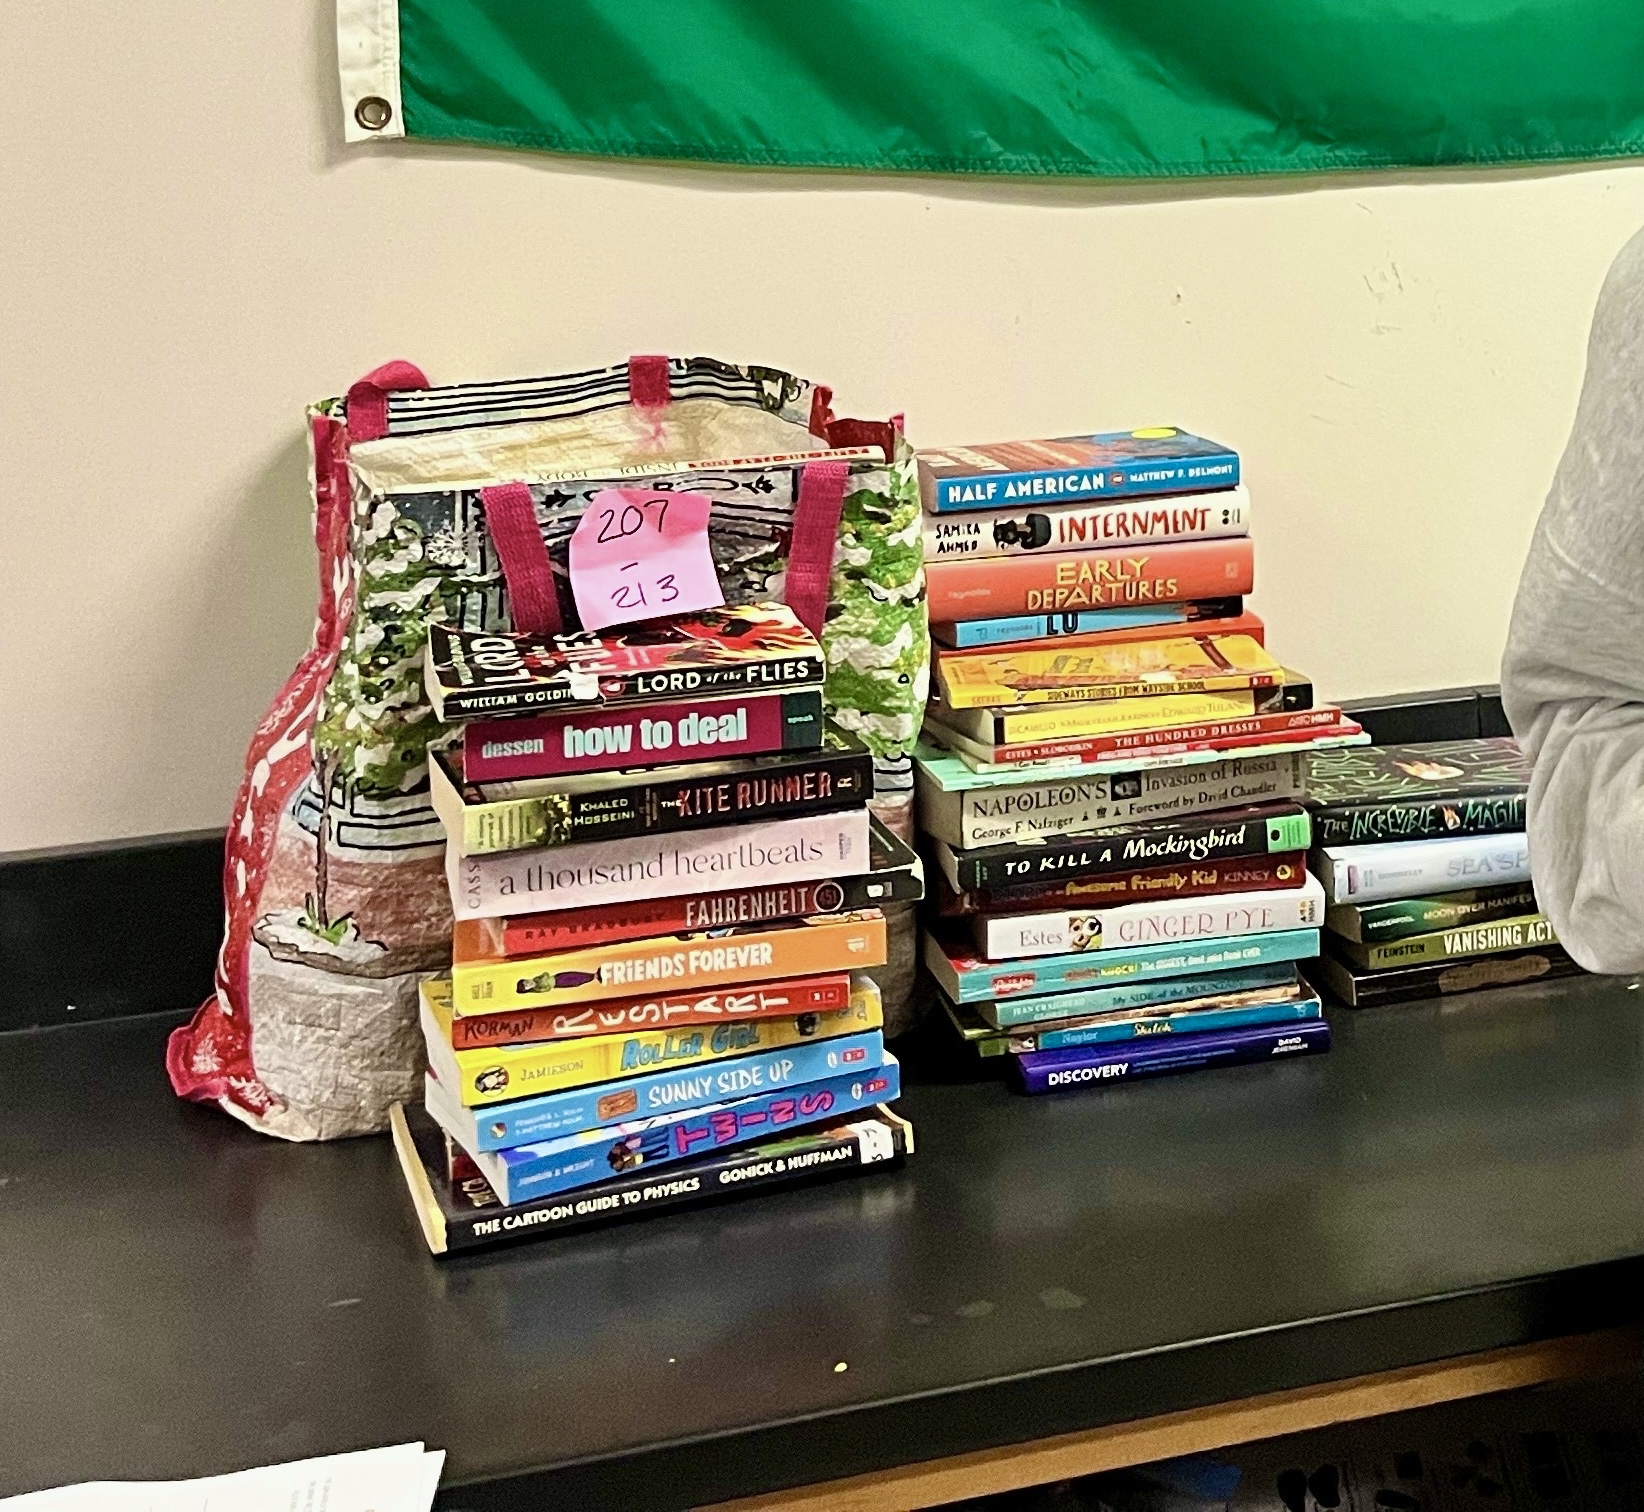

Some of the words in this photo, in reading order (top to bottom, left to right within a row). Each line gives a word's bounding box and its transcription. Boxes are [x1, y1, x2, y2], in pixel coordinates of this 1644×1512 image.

[948, 482, 998, 503] HALF
[1004, 472, 1105, 498] AMERICAN
[1129, 470, 1175, 482] MATTHEW
[1188, 465, 1233, 478] DELMONT
[597, 500, 669, 544] 207
[1059, 507, 1212, 544] INTERNMENT
[1055, 556, 1151, 586] EARLY
[610, 574, 680, 609] 213
[1026, 578, 1179, 611] DEPARTURES
[470, 637, 530, 683] LORD
[637, 672, 701, 694] LORD
[746, 660, 809, 683] FLIES
[459, 693, 518, 709] WILLIAM
[481, 738, 544, 759] dessen
[563, 724, 633, 758] how
[639, 718, 673, 750] to
[678, 707, 748, 747] deal
[1114, 734, 1140, 748] THE
[1145, 728, 1207, 745] HUNDRED
[1211, 720, 1262, 737] DRESSES
[579, 798, 629, 813] KHALED
[661, 799, 682, 808] THE
[678, 783, 731, 818] KITE
[737, 771, 833, 810] RUNNER
[972, 780, 1107, 819] NAPOLEON'S
[1145, 770, 1207, 792] Invasion
[1211, 762, 1226, 781] of
[1232, 758, 1277, 778] Russia
[574, 810, 635, 827] HOSSEINI
[972, 825, 1012, 841] George
[1129, 794, 1179, 816] Foreword
[1183, 792, 1195, 807] by
[1198, 788, 1228, 804] David
[1230, 782, 1277, 799] Chandler
[1324, 818, 1350, 838] THE
[1349, 804, 1437, 840] INCREDIBLE
[500, 874, 517, 896] a
[526, 850, 664, 893] thousand
[674, 837, 824, 876] heartbeats
[1006, 860, 1030, 876] TO
[1039, 852, 1091, 872] KILL
[1100, 848, 1112, 862] A
[1123, 824, 1246, 861] Mockingbird
[1448, 859, 1493, 877] SEA
[467, 862, 482, 910] CASS
[1131, 872, 1188, 890] Friendly
[1192, 869, 1218, 886] Kid
[1224, 870, 1271, 883] KINNEY
[685, 886, 809, 928] FAHRENHEIT
[1423, 907, 1455, 920] MOON
[1457, 901, 1486, 915] OVER
[1487, 892, 1533, 910] MANIFES
[1020, 929, 1063, 948] Estes
[1119, 915, 1213, 943] GINGER
[1226, 908, 1275, 931] PYE
[1377, 942, 1426, 959] FEINSTEIN
[1443, 922, 1522, 955] VANISHING
[1527, 920, 1552, 944] ACT
[688, 941, 774, 975] FOREVER
[463, 1015, 535, 1041] KORMAN
[551, 992, 790, 1035] RESTART
[520, 1059, 584, 1081] JAMIESON
[620, 1031, 704, 1072] ROLLER
[710, 1022, 761, 1054] GIRL
[1278, 1036, 1302, 1047] DAVID
[648, 1073, 715, 1108] SUNNY
[717, 1065, 764, 1094] SIDE
[769, 1059, 794, 1082] UP
[1048, 1062, 1129, 1087] DISCOVERY
[675, 1090, 834, 1156] TWINS
[719, 1162, 773, 1184] GONICK
[775, 1159, 786, 1174] &
[788, 1145, 853, 1169] HUFFMAN
[473, 1216, 500, 1236] THE
[503, 1205, 573, 1230] CARTOON
[575, 1195, 619, 1216] GUIDE
[622, 1191, 641, 1208] TO
[643, 1177, 700, 1202] PHYSICS
